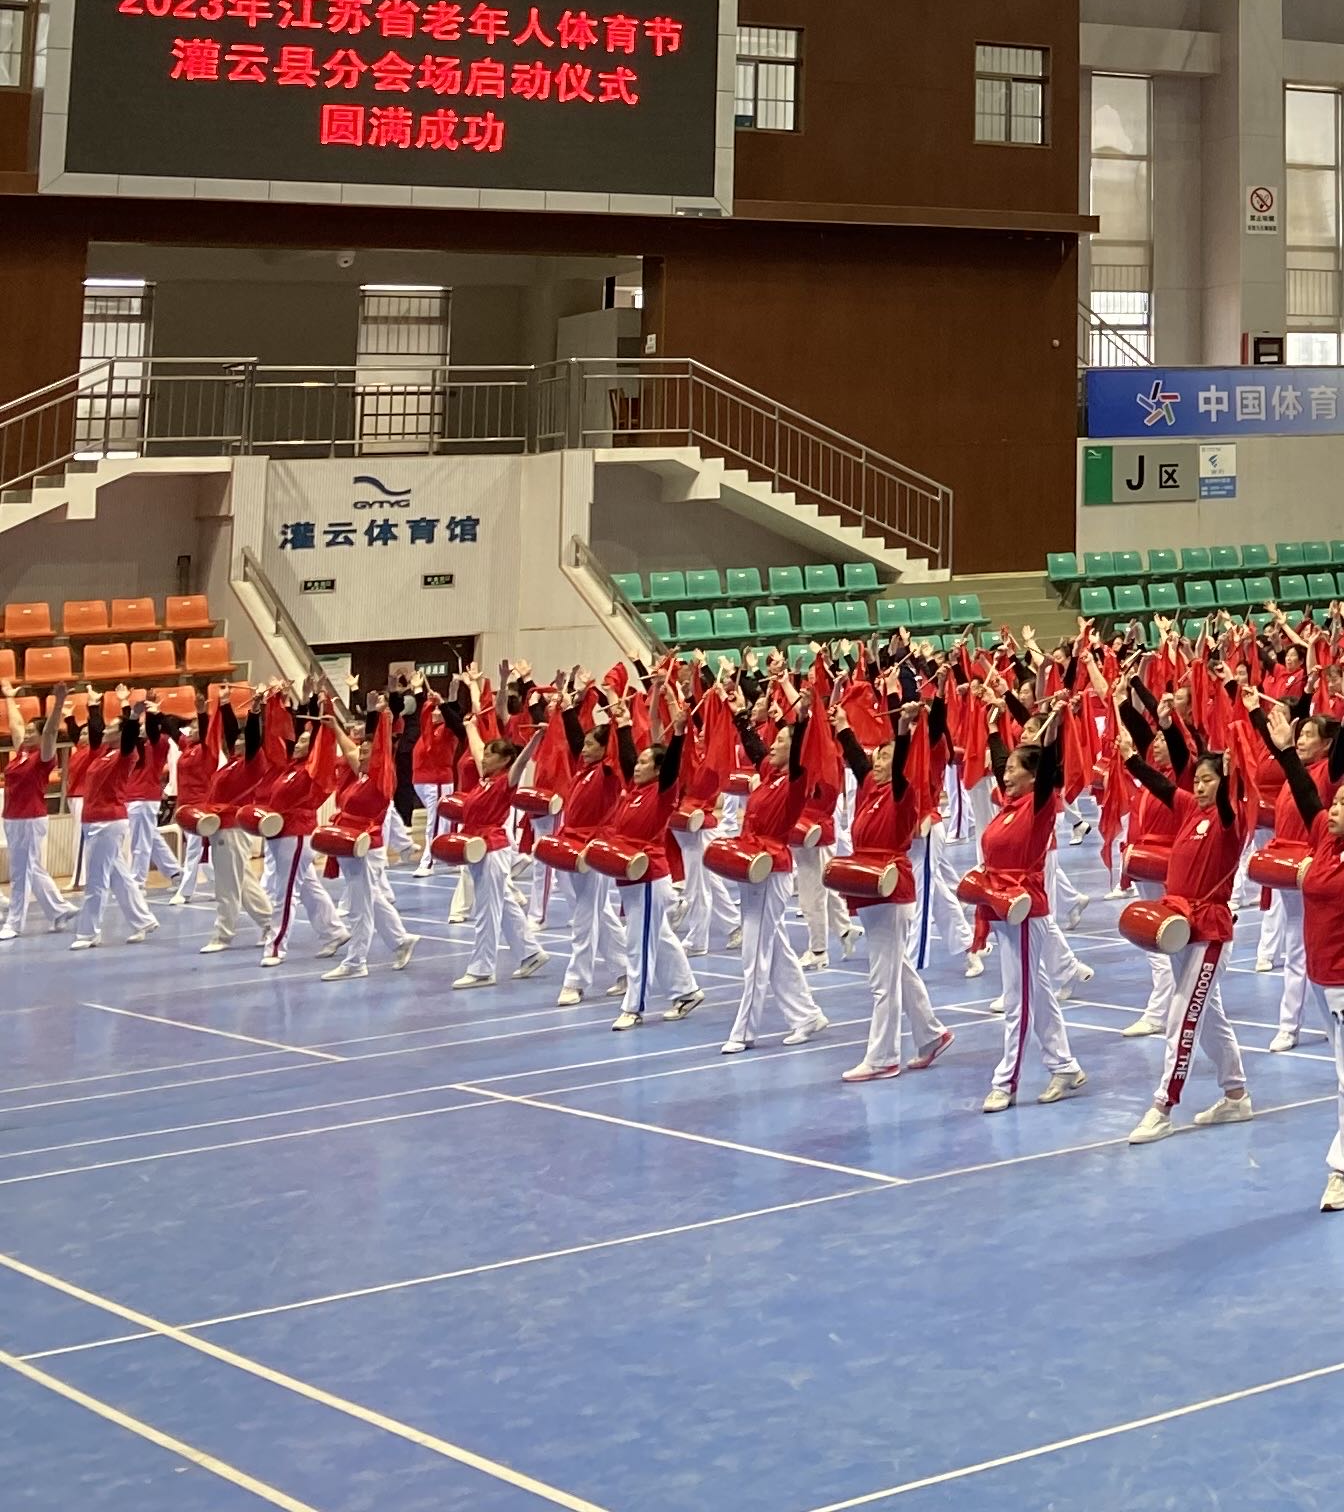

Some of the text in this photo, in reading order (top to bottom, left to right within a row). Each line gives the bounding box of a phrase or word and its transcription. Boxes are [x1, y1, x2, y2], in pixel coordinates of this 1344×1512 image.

[170, 37, 639, 106] 灌云县分会场启动仪式
[320, 103, 505, 153] 圆满成功
[1126, 455, 1180, 491] J区
[279, 515, 480, 550] 灌云体育馆
[1174, 1053, 1190, 1080] THE
